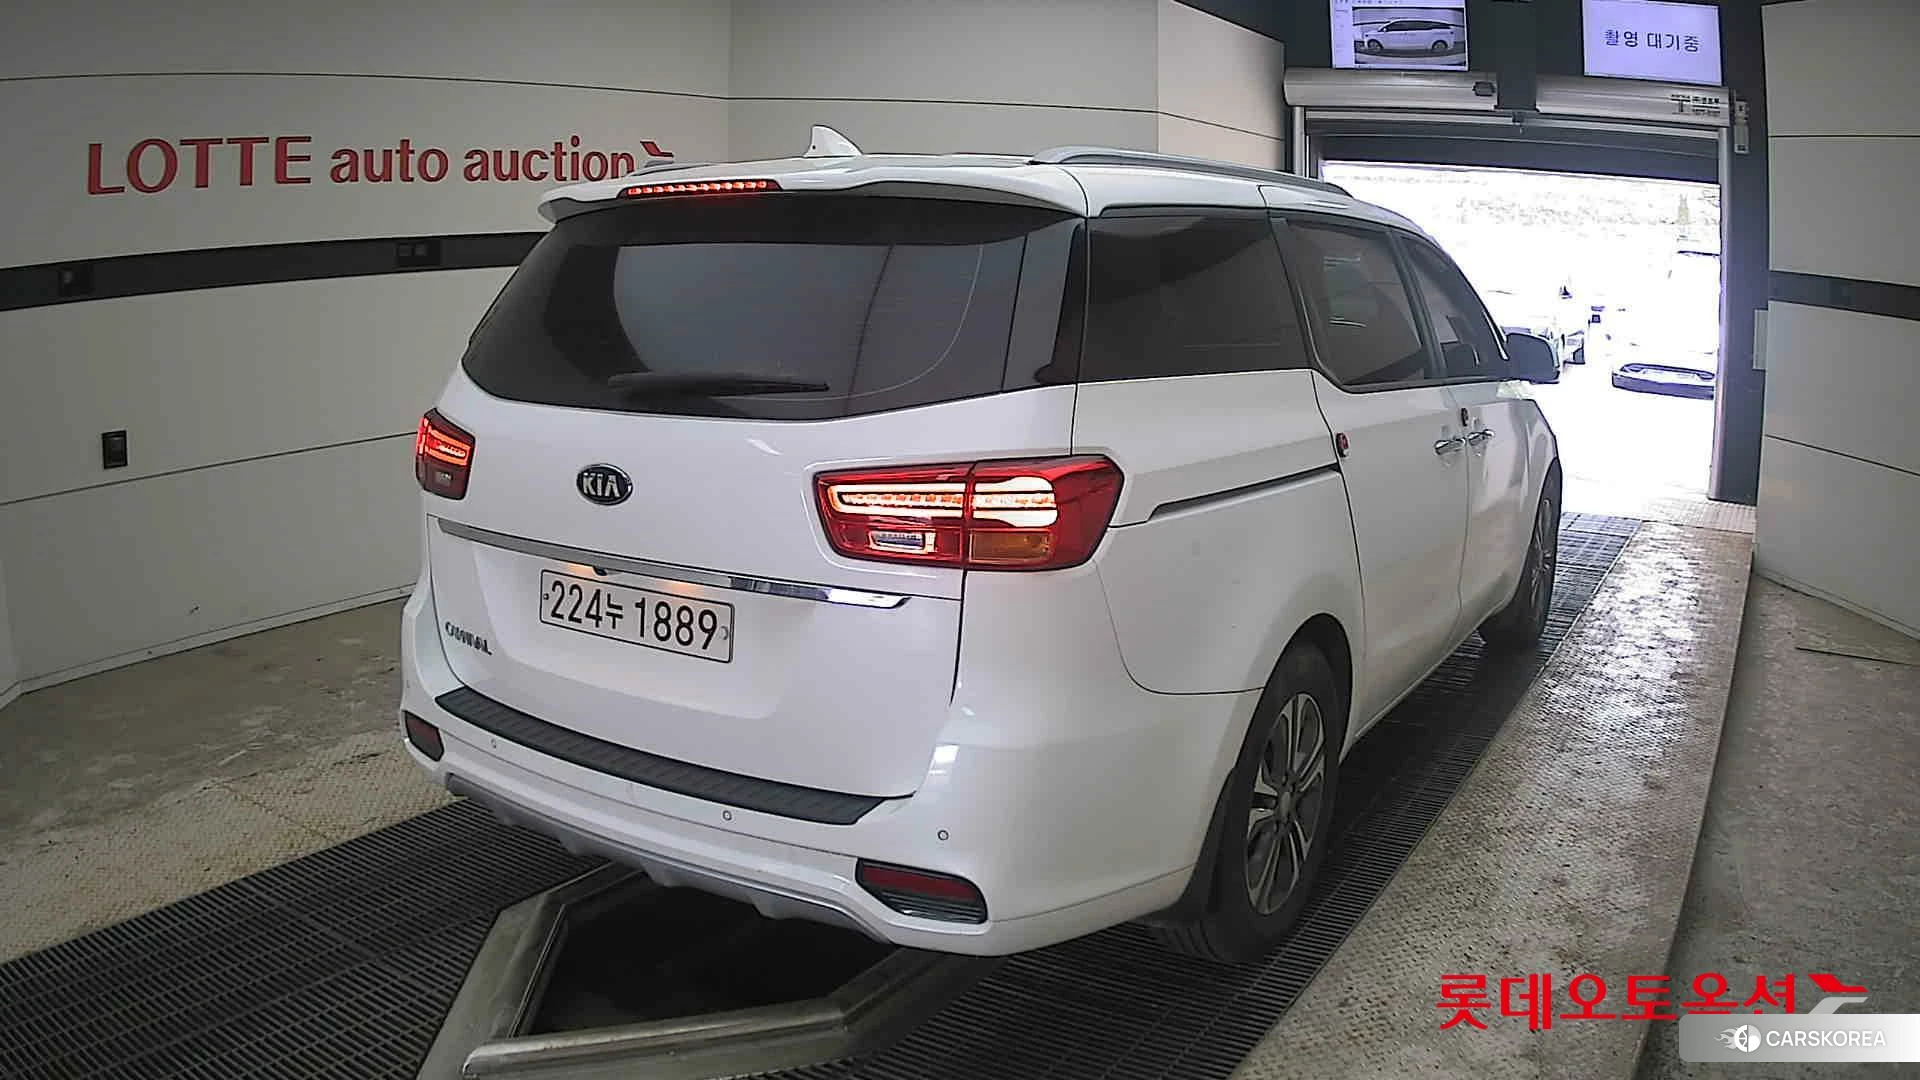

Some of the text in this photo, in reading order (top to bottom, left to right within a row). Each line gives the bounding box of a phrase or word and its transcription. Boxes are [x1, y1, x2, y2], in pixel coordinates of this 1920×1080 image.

[1646, 31, 1700, 53] 대기중
[88, 135, 635, 195] LOTTE auto auction
[583, 471, 621, 498] KIA
[550, 579, 719, 651] 224누 1889
